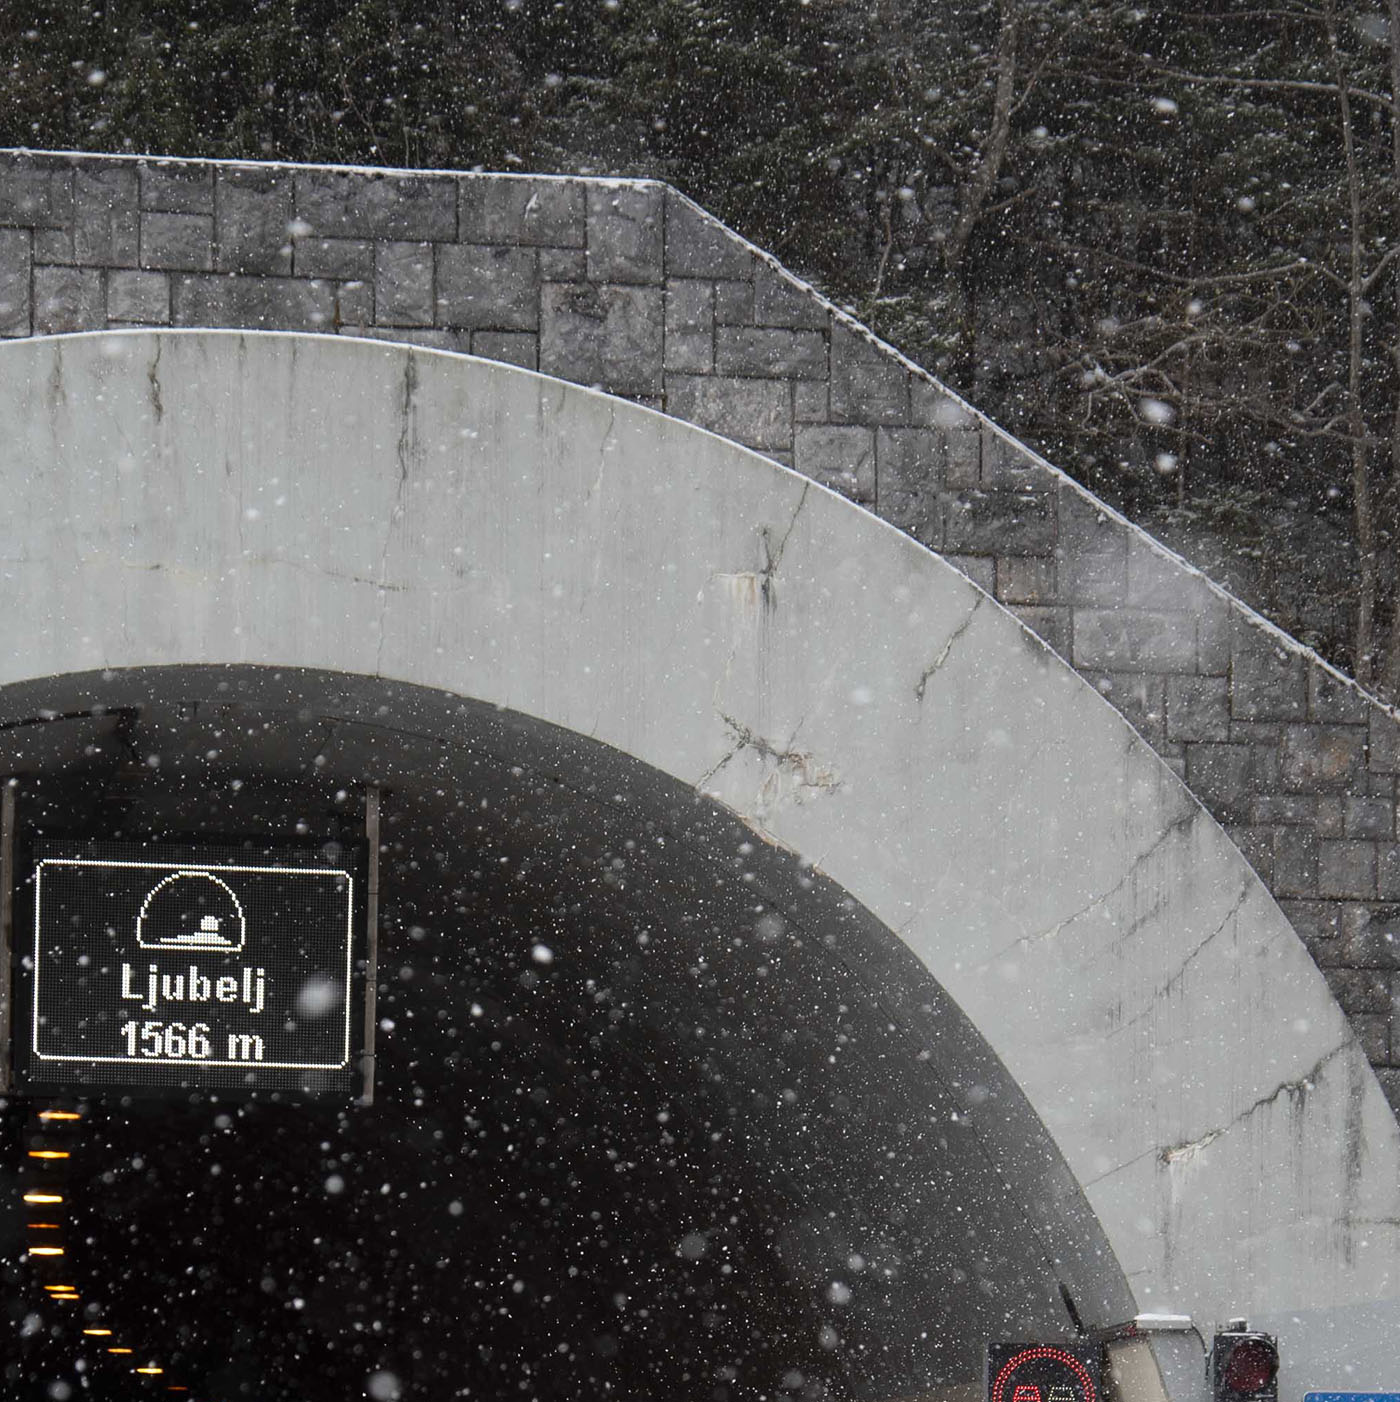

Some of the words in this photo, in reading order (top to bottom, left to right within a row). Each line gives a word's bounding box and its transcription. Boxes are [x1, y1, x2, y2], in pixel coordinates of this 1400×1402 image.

[121, 963, 265, 1013] Ljubelj
[120, 1020, 210, 1059] 1566
[228, 1033, 264, 1060] m
